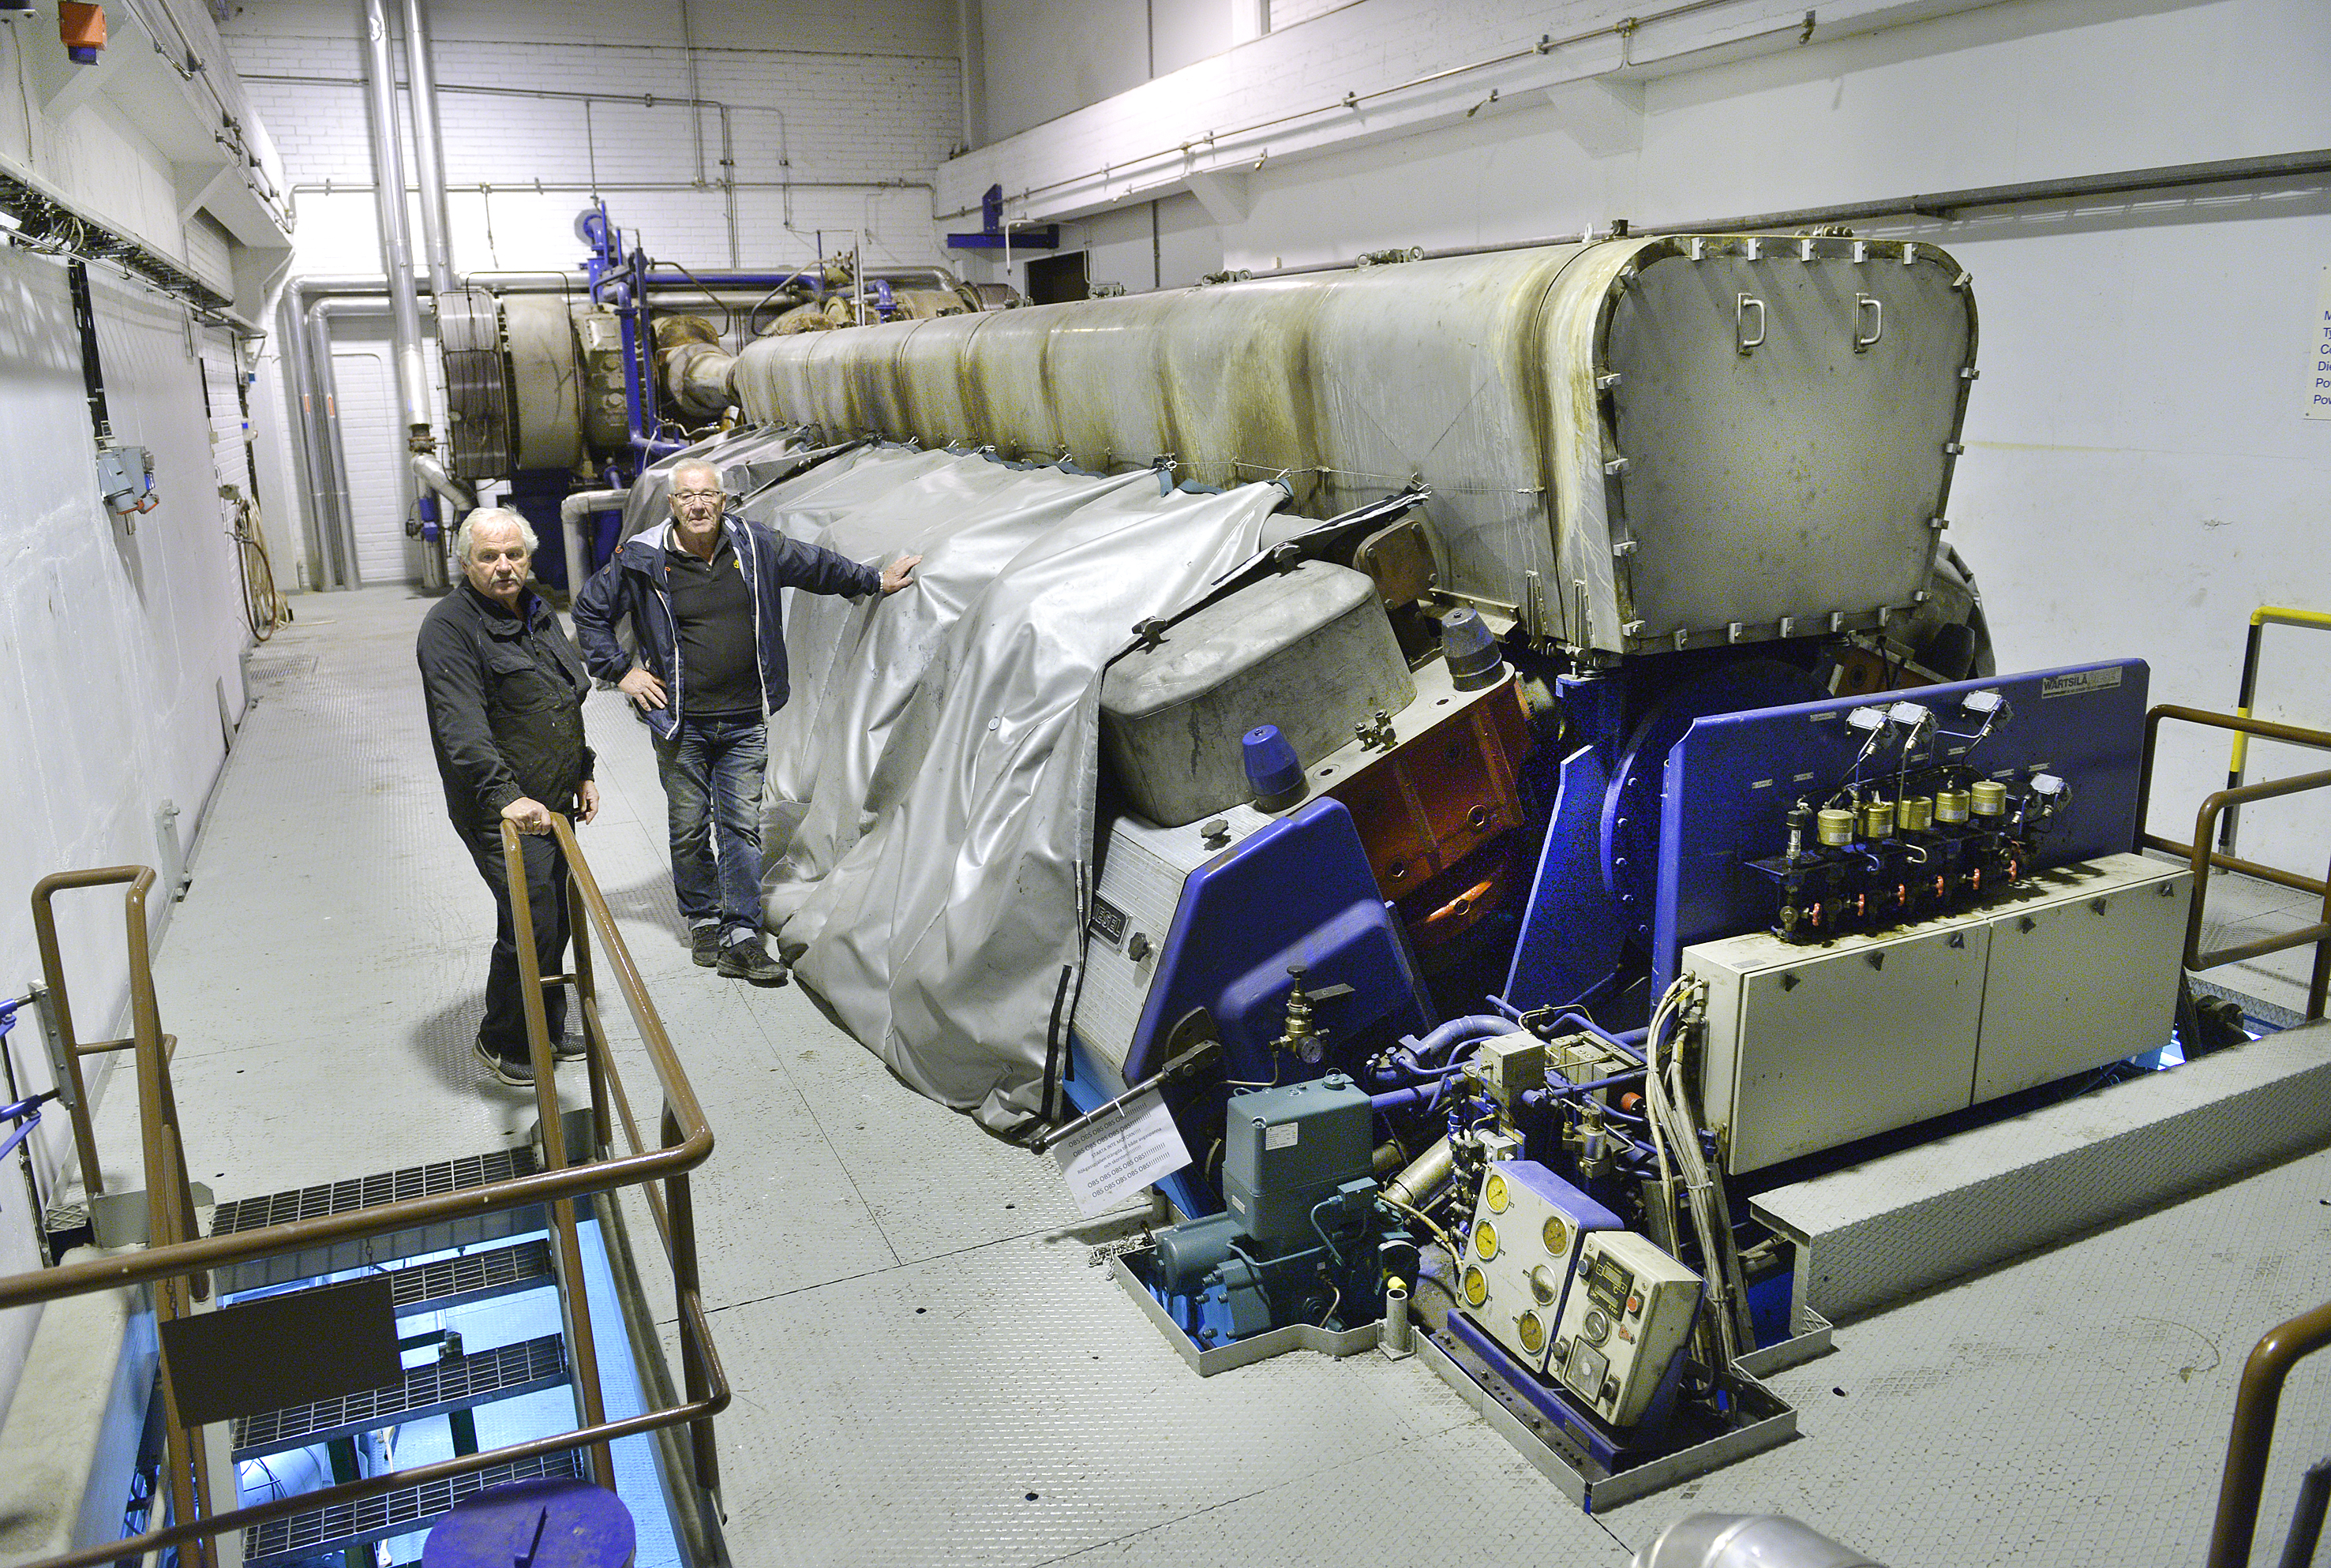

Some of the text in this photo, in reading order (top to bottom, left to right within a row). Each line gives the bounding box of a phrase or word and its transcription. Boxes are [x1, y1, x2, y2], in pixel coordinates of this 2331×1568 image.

[2315, 378, 2331, 388] Po
[2044, 673, 2088, 690] WÄRTSILÄ
[1069, 1138, 1081, 1148] OBS
[1081, 1132, 1092, 1141] OBS
[1092, 1125, 1104, 1135] OBS
[1104, 1120, 1116, 1129] OBS
[1073, 1148, 1085, 1158] OBS
[1085, 1142, 1097, 1151] OBS
[1096, 1136, 1108, 1145] OBS
[1108, 1129, 1120, 1139] OBS
[1092, 1147, 1107, 1158] STARTA
[1088, 1179, 1100, 1188] OBS
[1100, 1173, 1111, 1182] OBS
[1111, 1166, 1123, 1176] OBS
[1122, 1160, 1134, 1169] OBS
[1092, 1188, 1104, 1198] OBS
[1104, 1182, 1116, 1192] OBS
[1115, 1176, 1127, 1184] OBS
[1127, 1169, 1139, 1178] OBS
